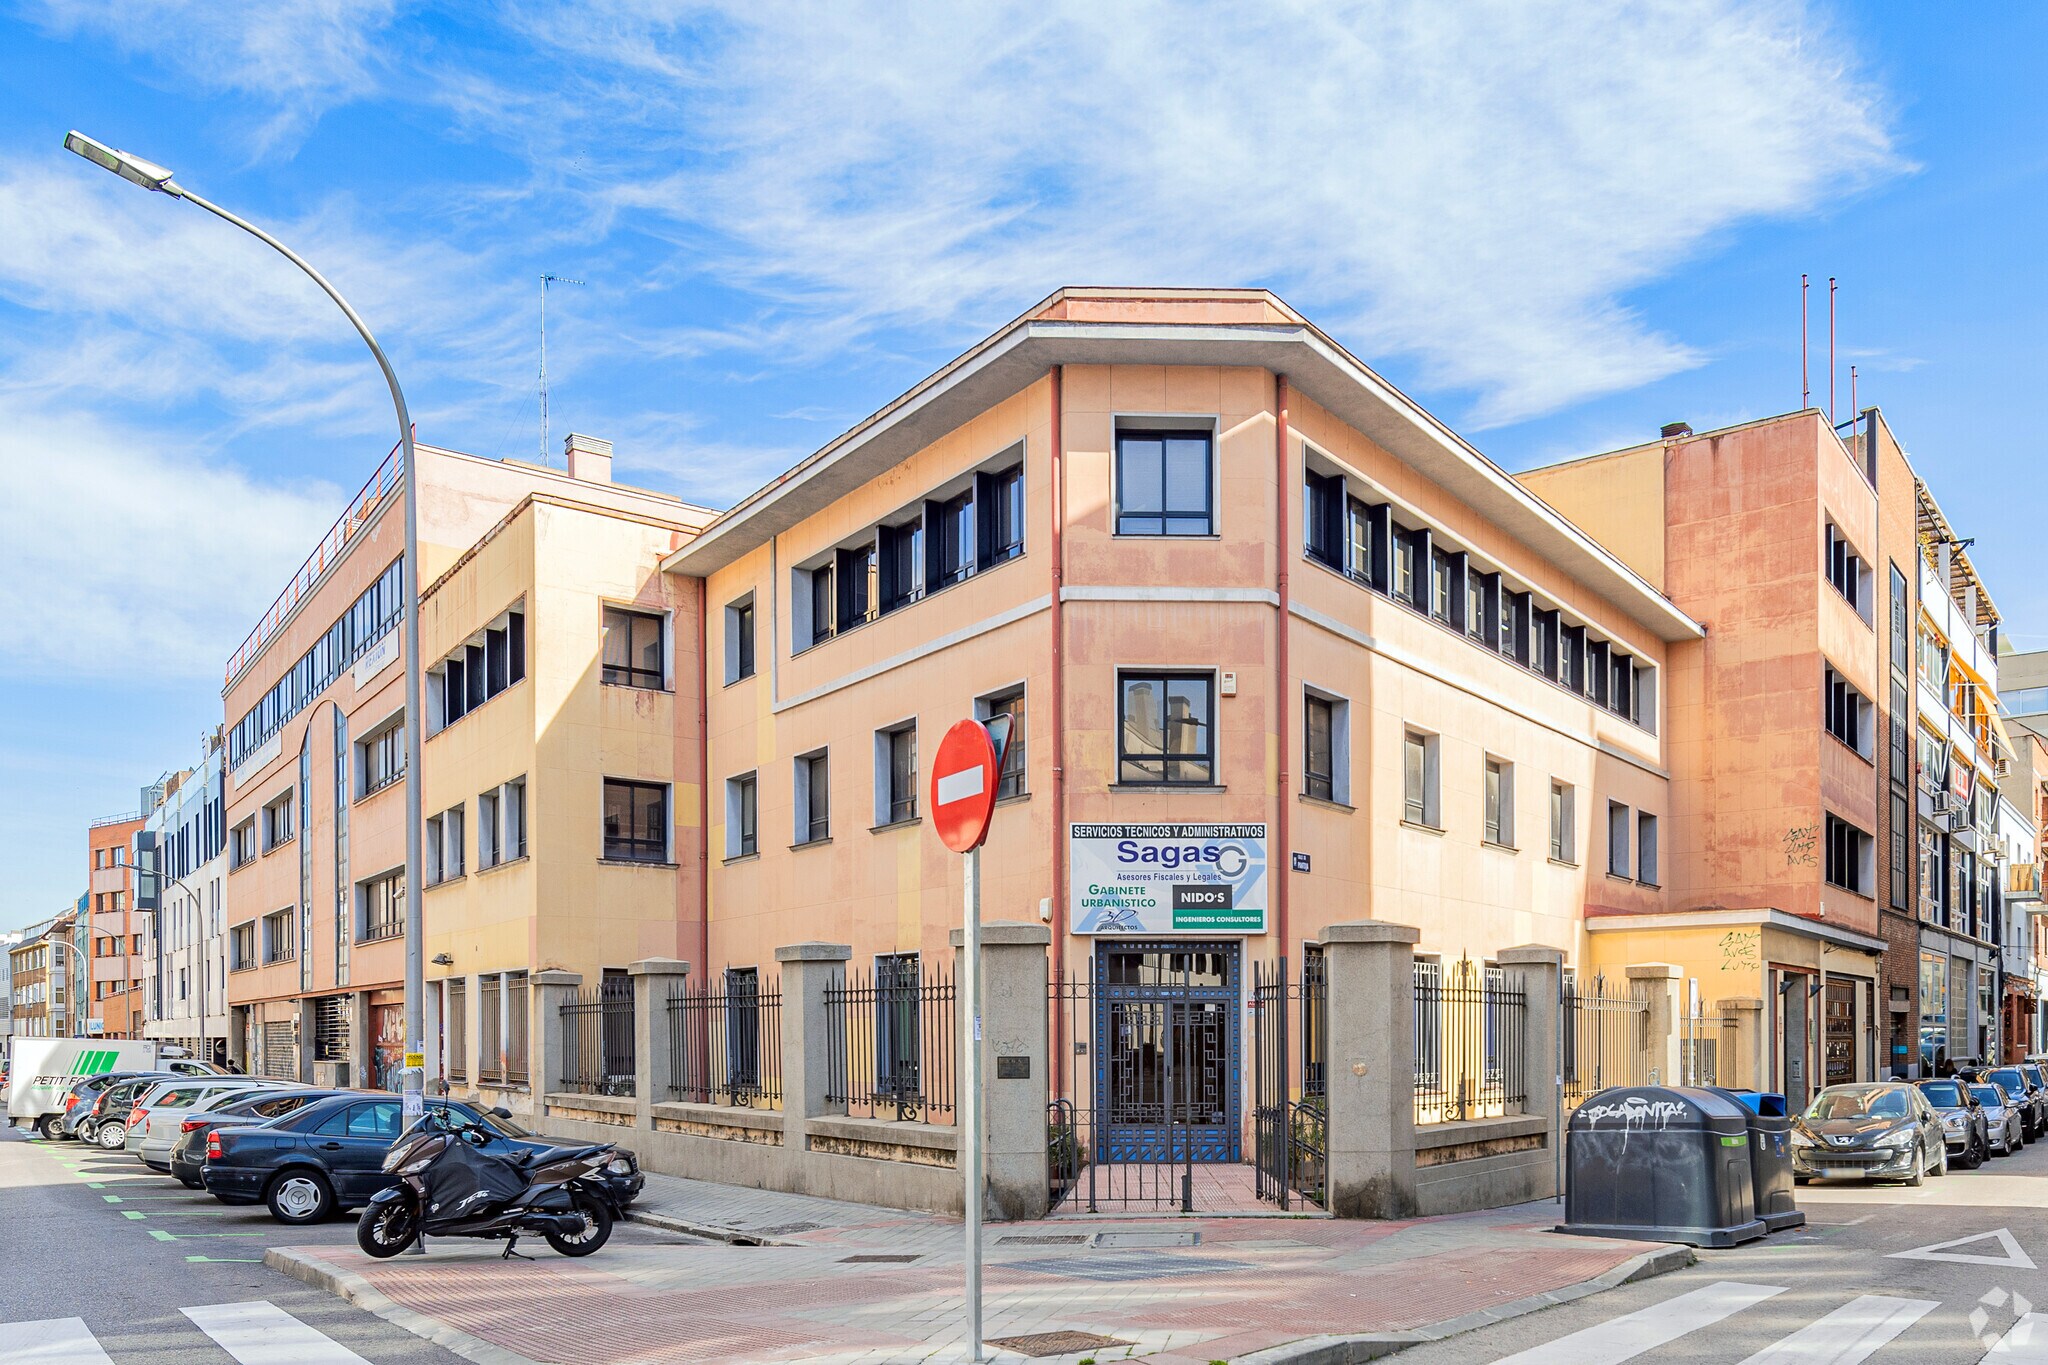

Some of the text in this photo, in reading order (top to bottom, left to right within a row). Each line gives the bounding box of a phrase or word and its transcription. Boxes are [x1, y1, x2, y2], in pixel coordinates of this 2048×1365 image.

[1074, 826, 1264, 838] SERVICIOS TECNICOS Y ADMINISTRATIVOS
[1117, 840, 1221, 868] Sagas
[1117, 873, 1222, 883] Asesores Fiscales y Legales
[1088, 884, 1146, 895] GABINETE
[1081, 898, 1156, 908] URBANISTICO
[1180, 892, 1225, 903] NIDO'S
[32, 1076, 66, 1086] PETIT
